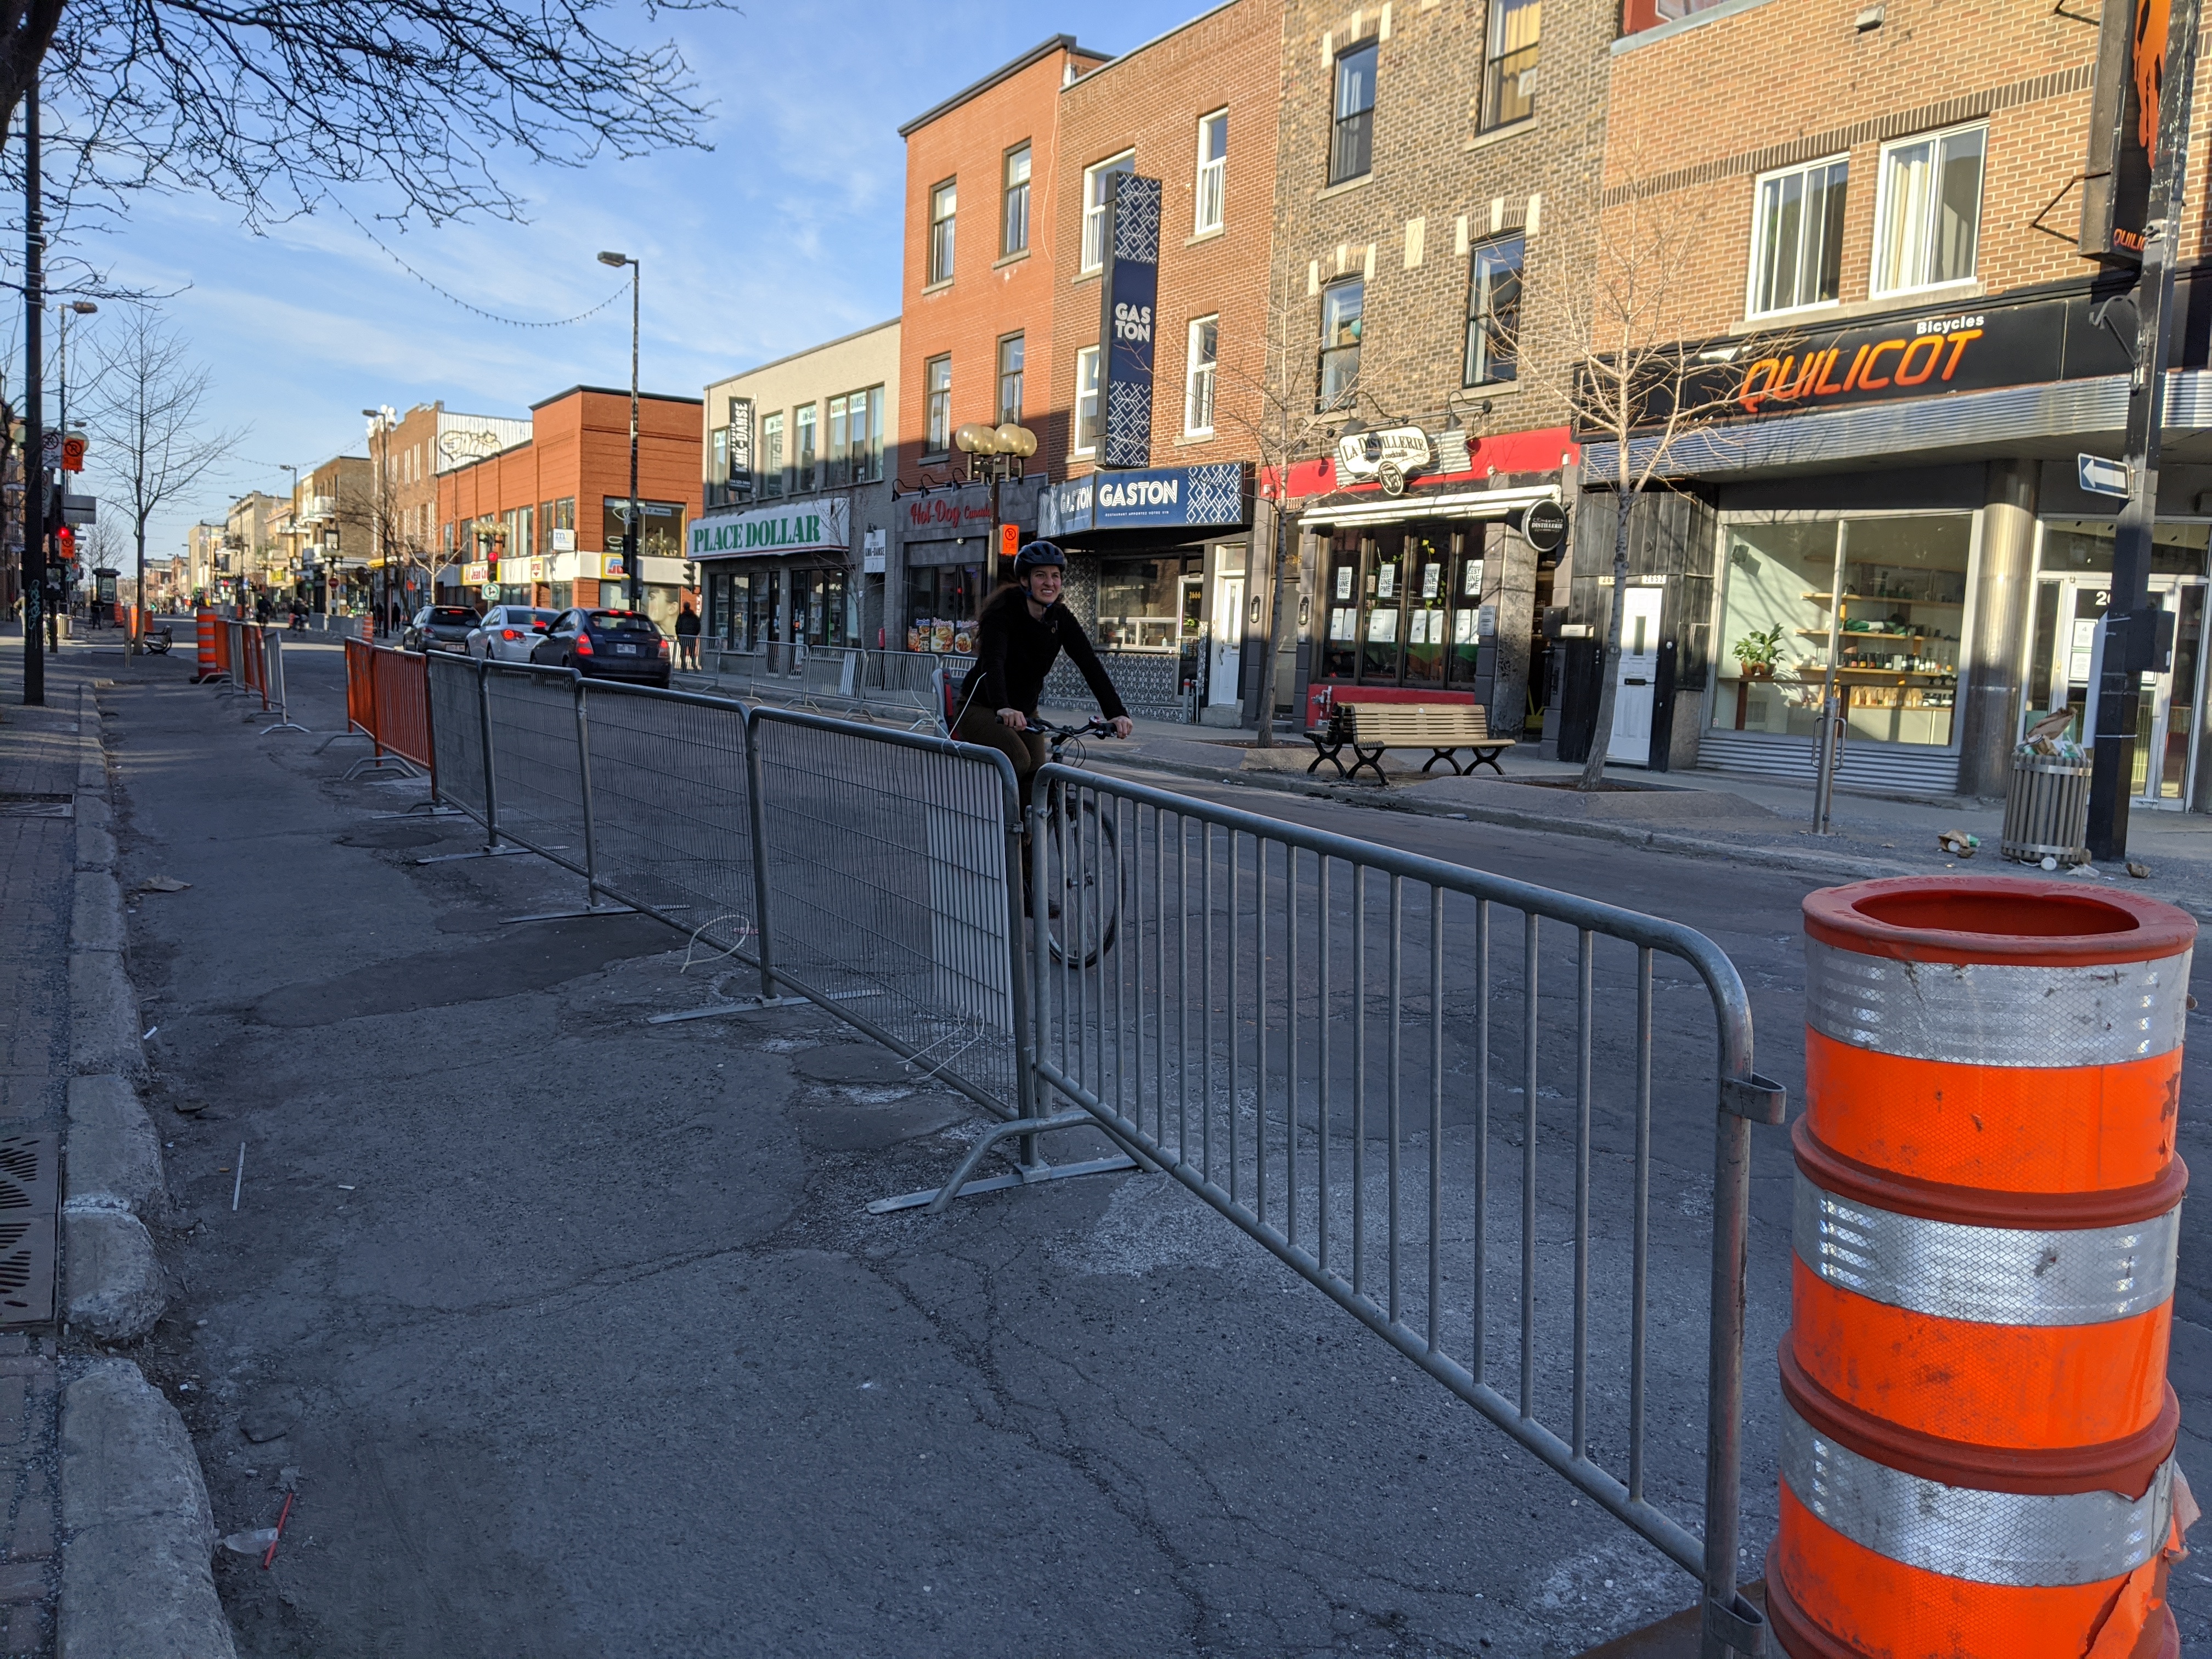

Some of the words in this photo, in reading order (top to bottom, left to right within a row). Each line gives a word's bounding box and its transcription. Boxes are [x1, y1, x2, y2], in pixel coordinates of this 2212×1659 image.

[1115, 303, 1151, 324] GAS
[1916, 314, 1984, 335] Bicycles
[1115, 320, 1150, 342] TON
[1737, 329, 1983, 413] QUILICOT
[1342, 445, 1358, 461] LA
[1357, 435, 1427, 454] DISTILLERIE
[1099, 479, 1178, 506] GASTON
[911, 499, 961, 528] Hot-Dog
[693, 523, 743, 552] PLACE
[745, 514, 821, 548] DOLLAR
